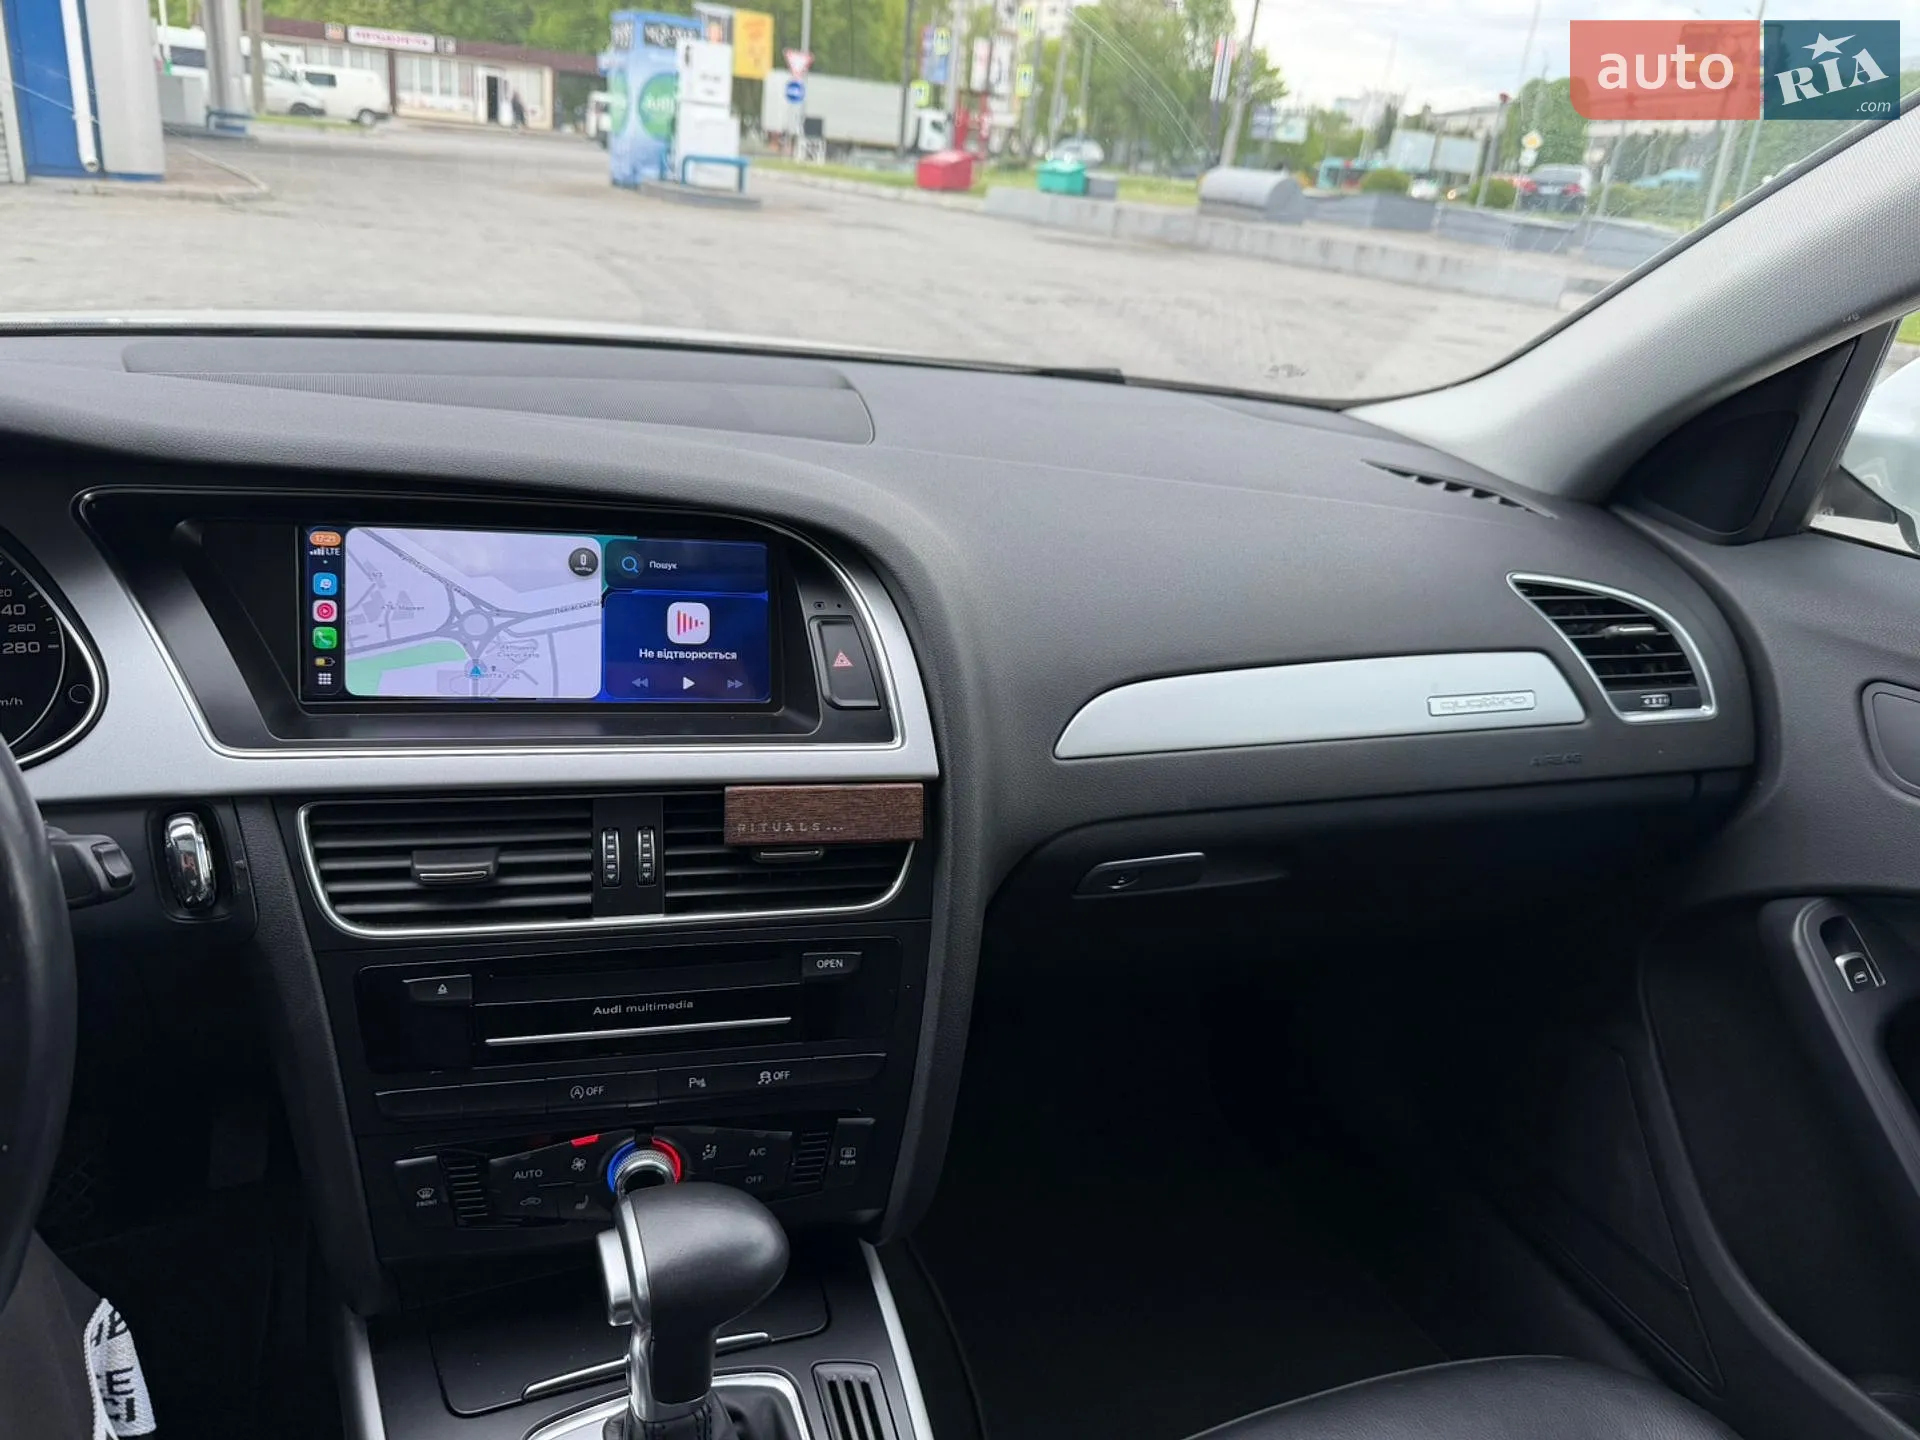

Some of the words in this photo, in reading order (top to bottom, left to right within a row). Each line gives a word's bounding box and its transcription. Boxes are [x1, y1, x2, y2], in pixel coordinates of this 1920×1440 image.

[649, 560, 678, 570] Пошук
[8, 623, 36, 633] 260
[2, 641, 41, 654] 280
[639, 648, 655, 659] Не
[657, 648, 738, 660] відтворюється
[1439, 695, 1527, 711] quattro
[816, 958, 844, 969] OPEN
[592, 1004, 623, 1016] Audi
[625, 1000, 695, 1014] multimedia
[772, 1070, 791, 1081] OFF
[586, 1085, 605, 1097] OFF
[748, 1147, 767, 1157] A/C
[513, 1168, 543, 1180] AUTO
[745, 1175, 765, 1184] OFF
